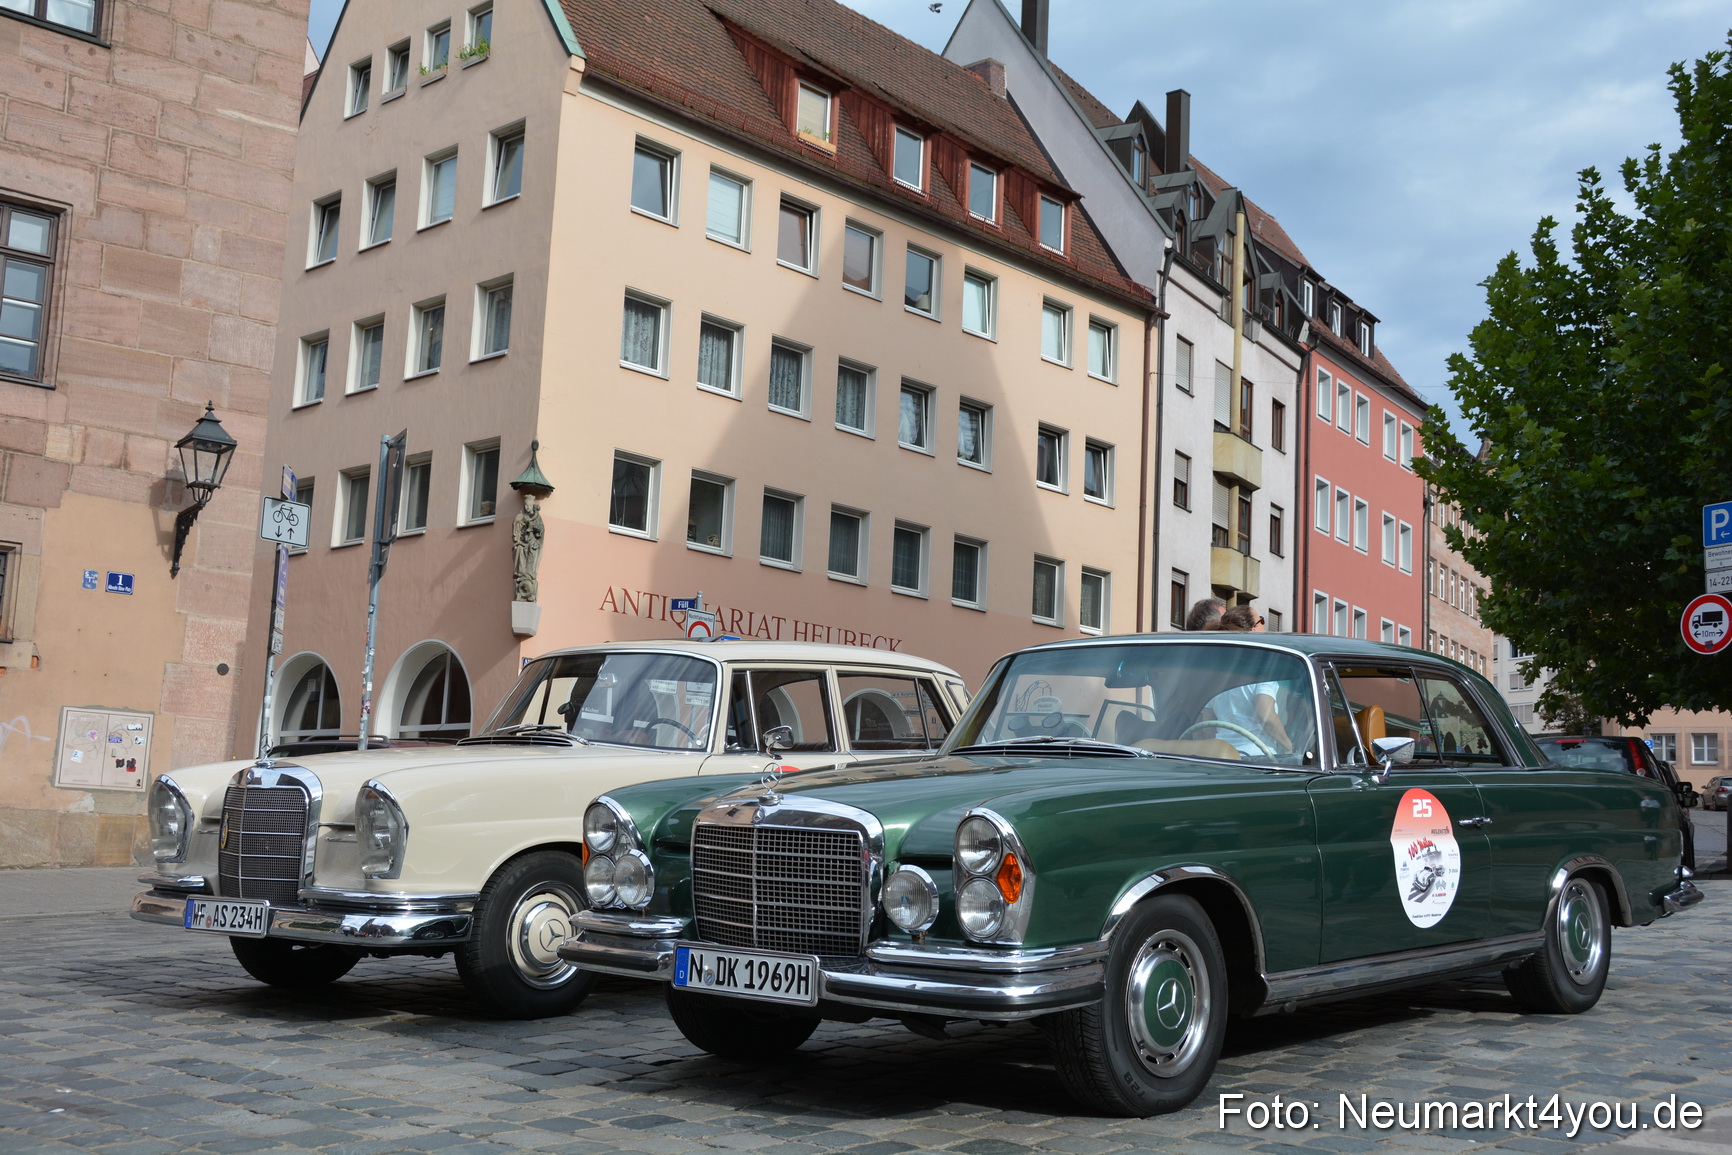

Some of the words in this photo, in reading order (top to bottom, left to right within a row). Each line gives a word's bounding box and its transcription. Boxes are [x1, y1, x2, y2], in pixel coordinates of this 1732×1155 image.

[1711, 508, 1730, 541] P
[117, 574, 123, 586] 1
[598, 585, 787, 638] ANTIQARIAT
[1412, 799, 1433, 818] 25
[213, 904, 229, 928] AS
[229, 905, 264, 930] 234H
[679, 970, 685, 979] D
[689, 953, 704, 983] N
[715, 956, 740, 988] DK
[743, 959, 811, 996] 1969H
